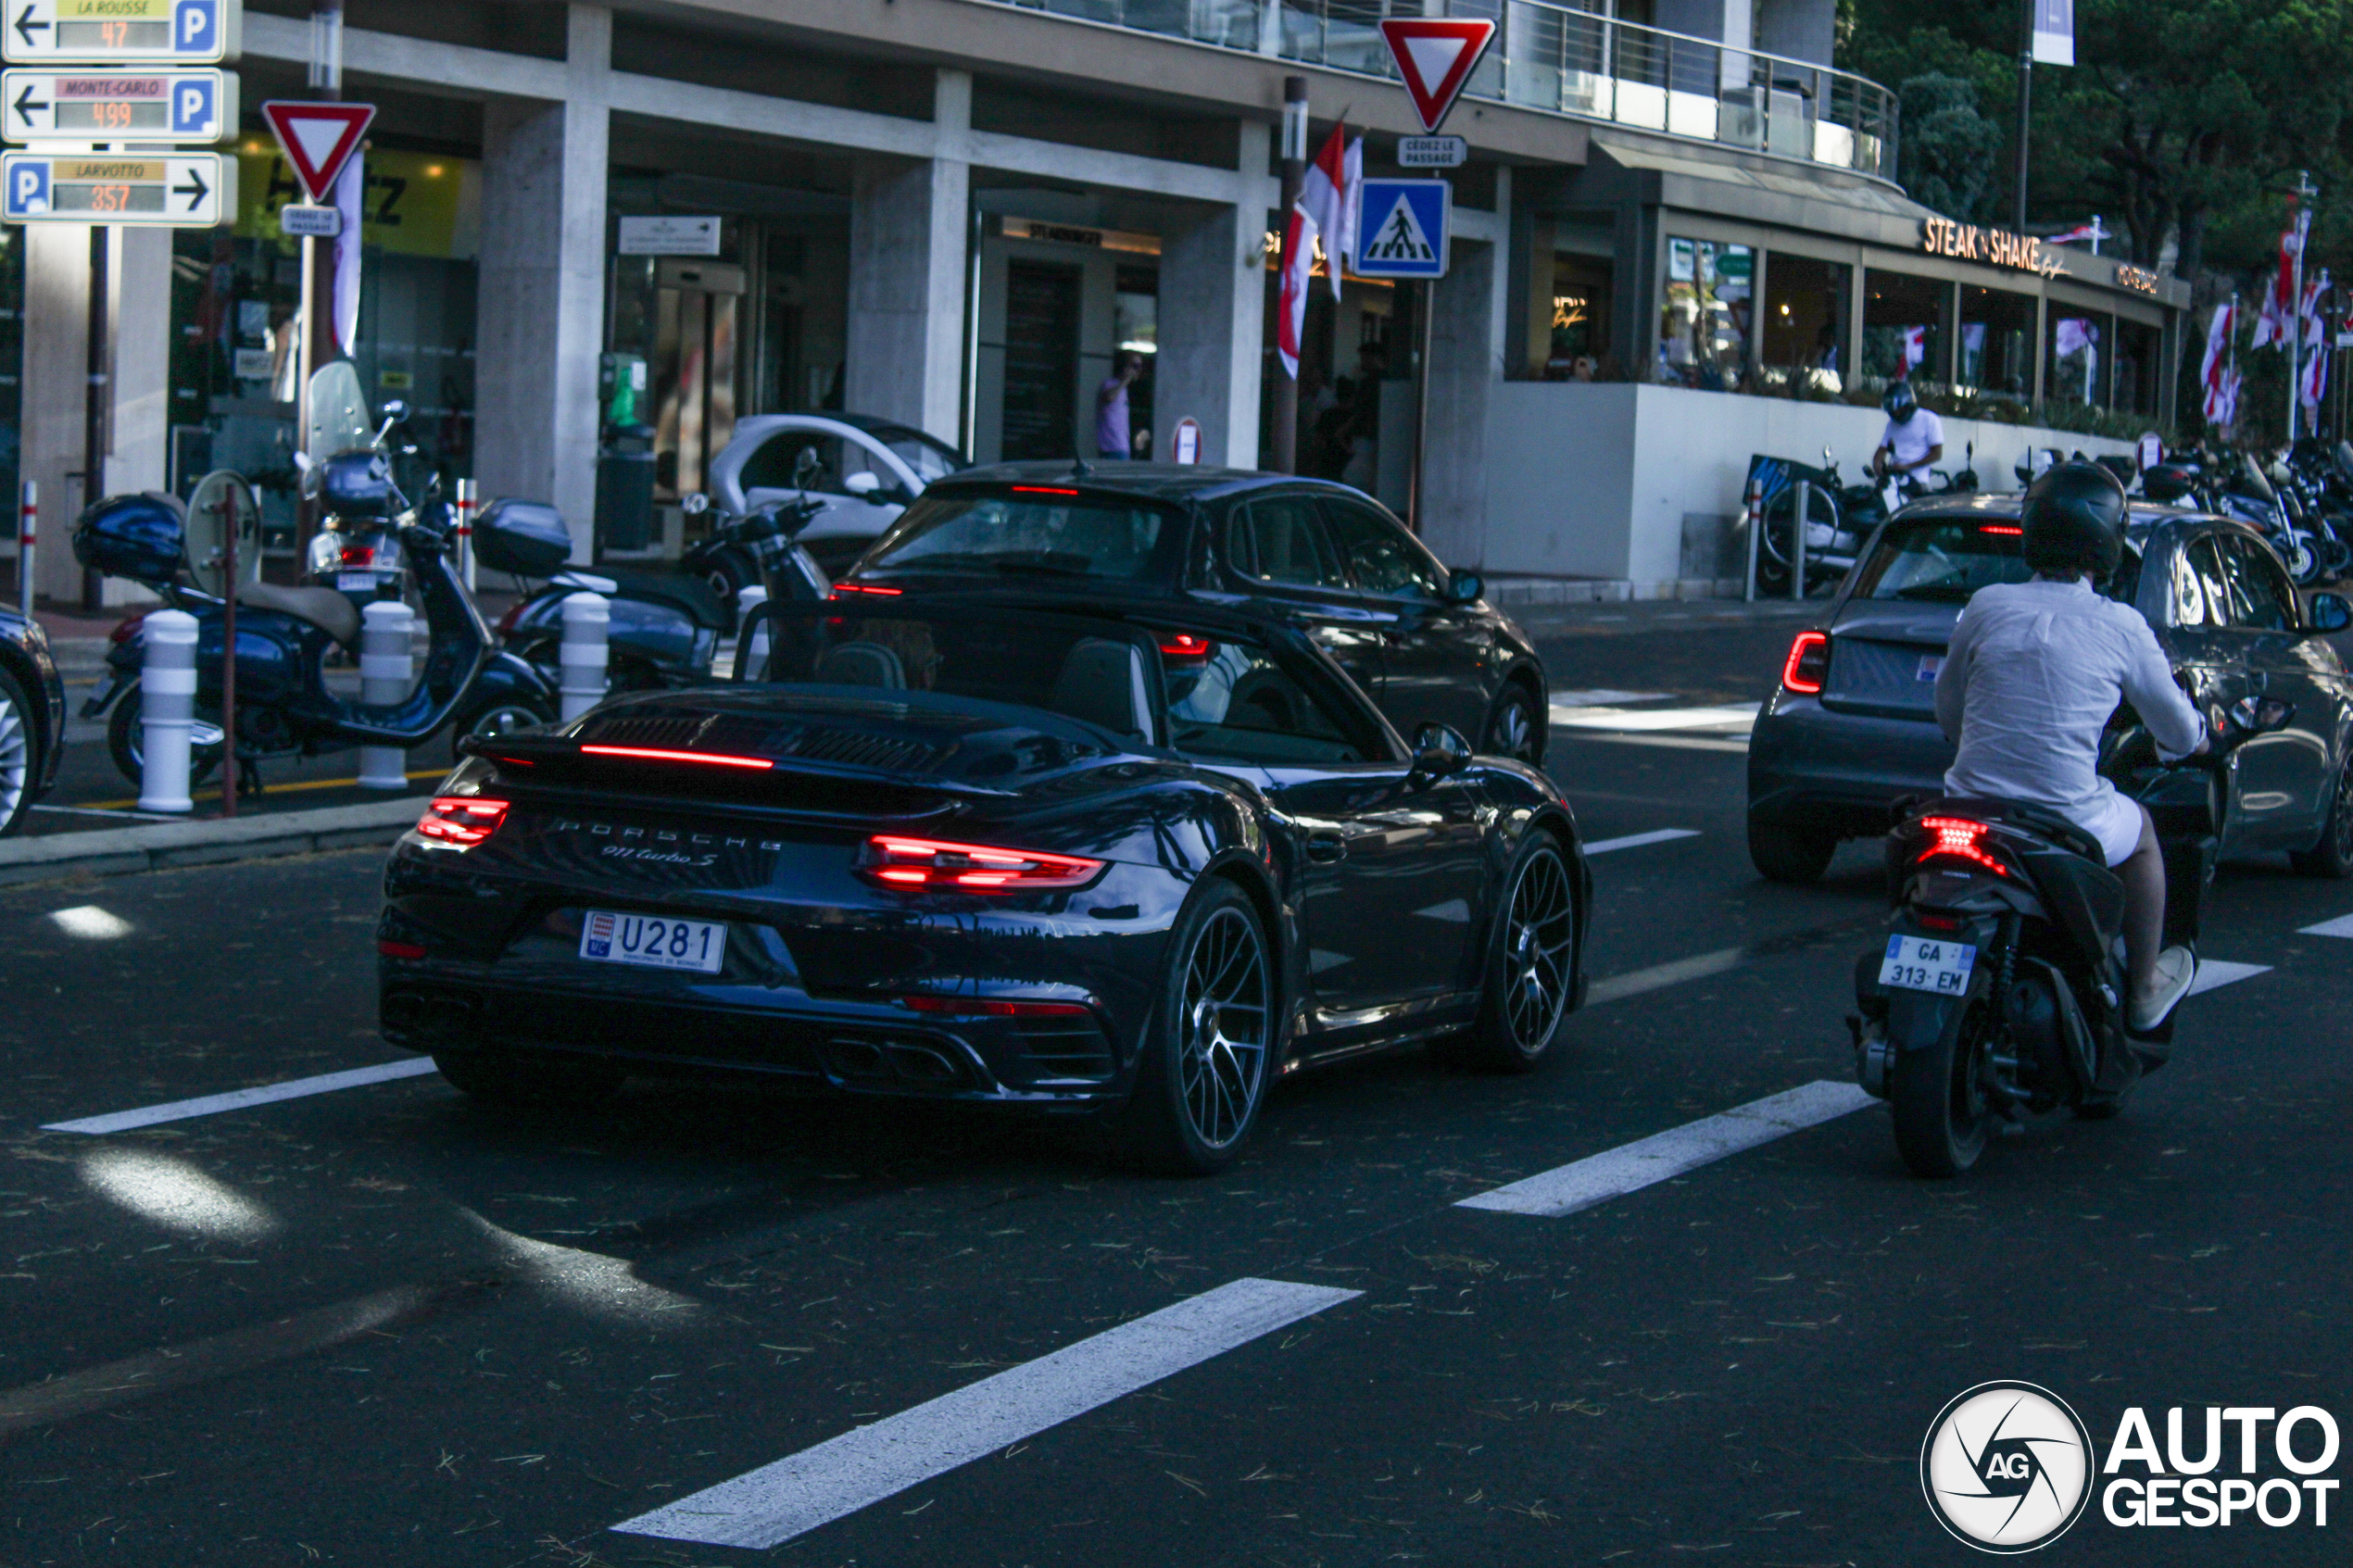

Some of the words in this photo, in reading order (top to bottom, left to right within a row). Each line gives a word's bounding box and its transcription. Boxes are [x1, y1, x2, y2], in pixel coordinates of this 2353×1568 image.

[77, 1, 94, 15] LA
[96, 0, 149, 15] ROUSSE
[101, 22, 128, 47] 47
[65, 81, 159, 94] MONTE-CARLO
[94, 103, 132, 128] 499
[1443, 141, 1454, 150] LE
[1406, 153, 1454, 164] PASSAGE
[77, 164, 145, 178] LARVOTTO
[92, 185, 130, 211] 357
[1925, 217, 1978, 259] STEAK
[1991, 228, 2041, 271] SHAKE
[560, 822, 782, 850] PORSCHE
[602, 845, 635, 858] 911
[636, 848, 691, 863] turbo
[689, 854, 719, 866] S
[590, 940, 607, 954] MC
[622, 918, 711, 960] U281
[1918, 943, 1941, 961] GA
[1891, 965, 1926, 985] 313
[1937, 972, 1962, 990] EM
